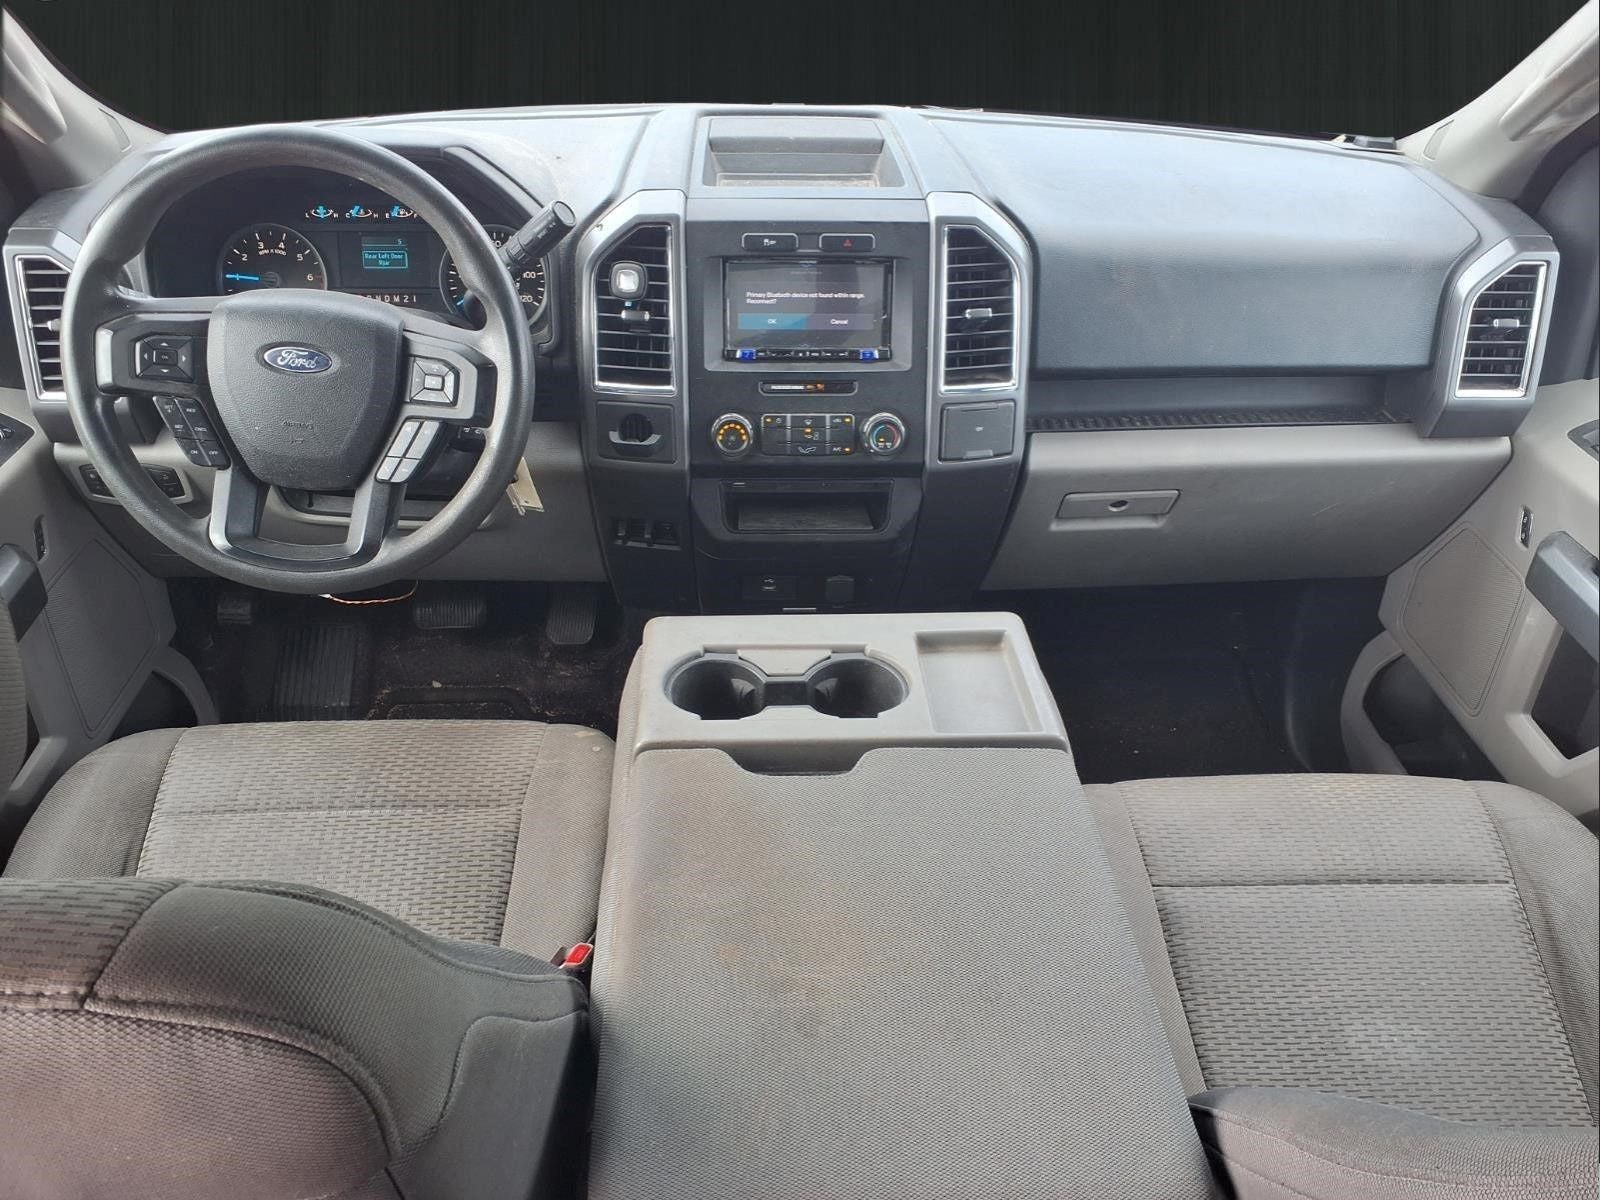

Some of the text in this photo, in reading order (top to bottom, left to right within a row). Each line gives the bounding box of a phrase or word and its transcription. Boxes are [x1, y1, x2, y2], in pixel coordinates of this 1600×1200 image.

[241, 253, 248, 261] 2
[296, 253, 304, 261] 5
[306, 273, 314, 281] 6
[523, 271, 536, 279] 100
[746, 291, 766, 299] Primary
[277, 349, 318, 369] Ford
